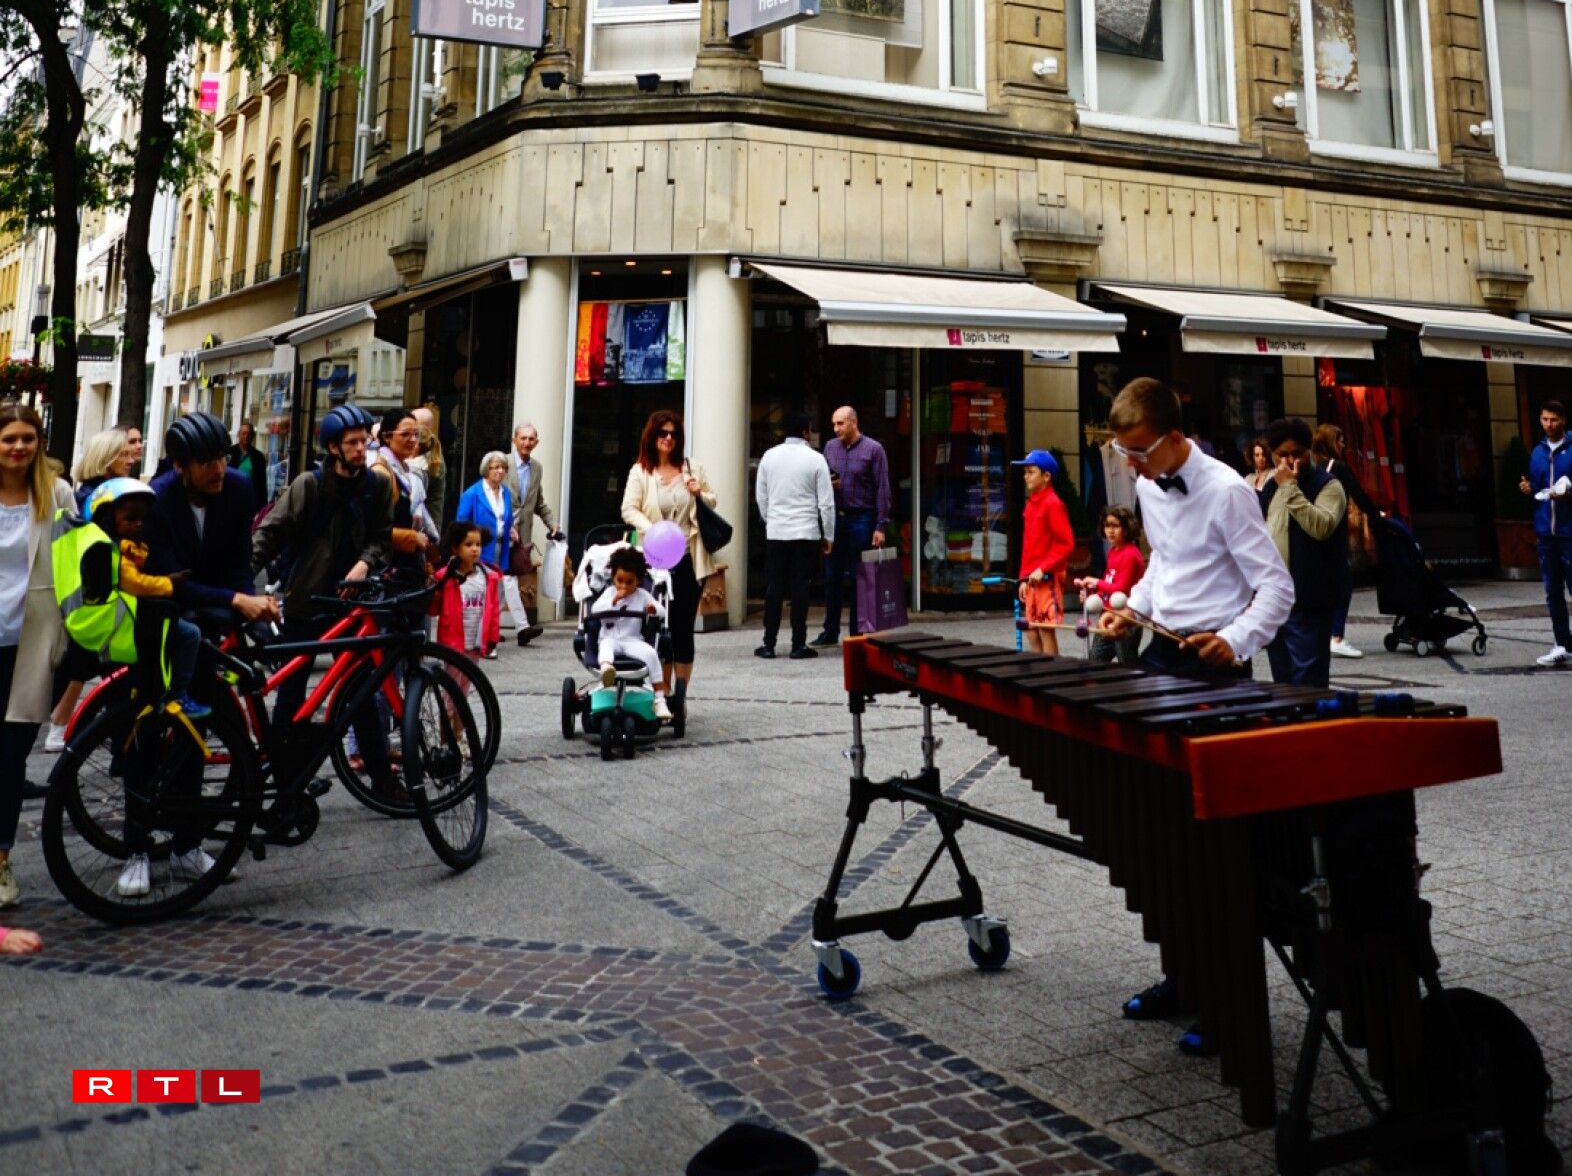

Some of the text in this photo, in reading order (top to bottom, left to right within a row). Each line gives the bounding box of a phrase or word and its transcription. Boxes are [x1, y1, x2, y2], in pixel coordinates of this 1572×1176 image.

[471, 8, 525, 31] hertz
[963, 331, 1010, 343] tapis hertz
[1267, 339, 1306, 351] tapis hertz
